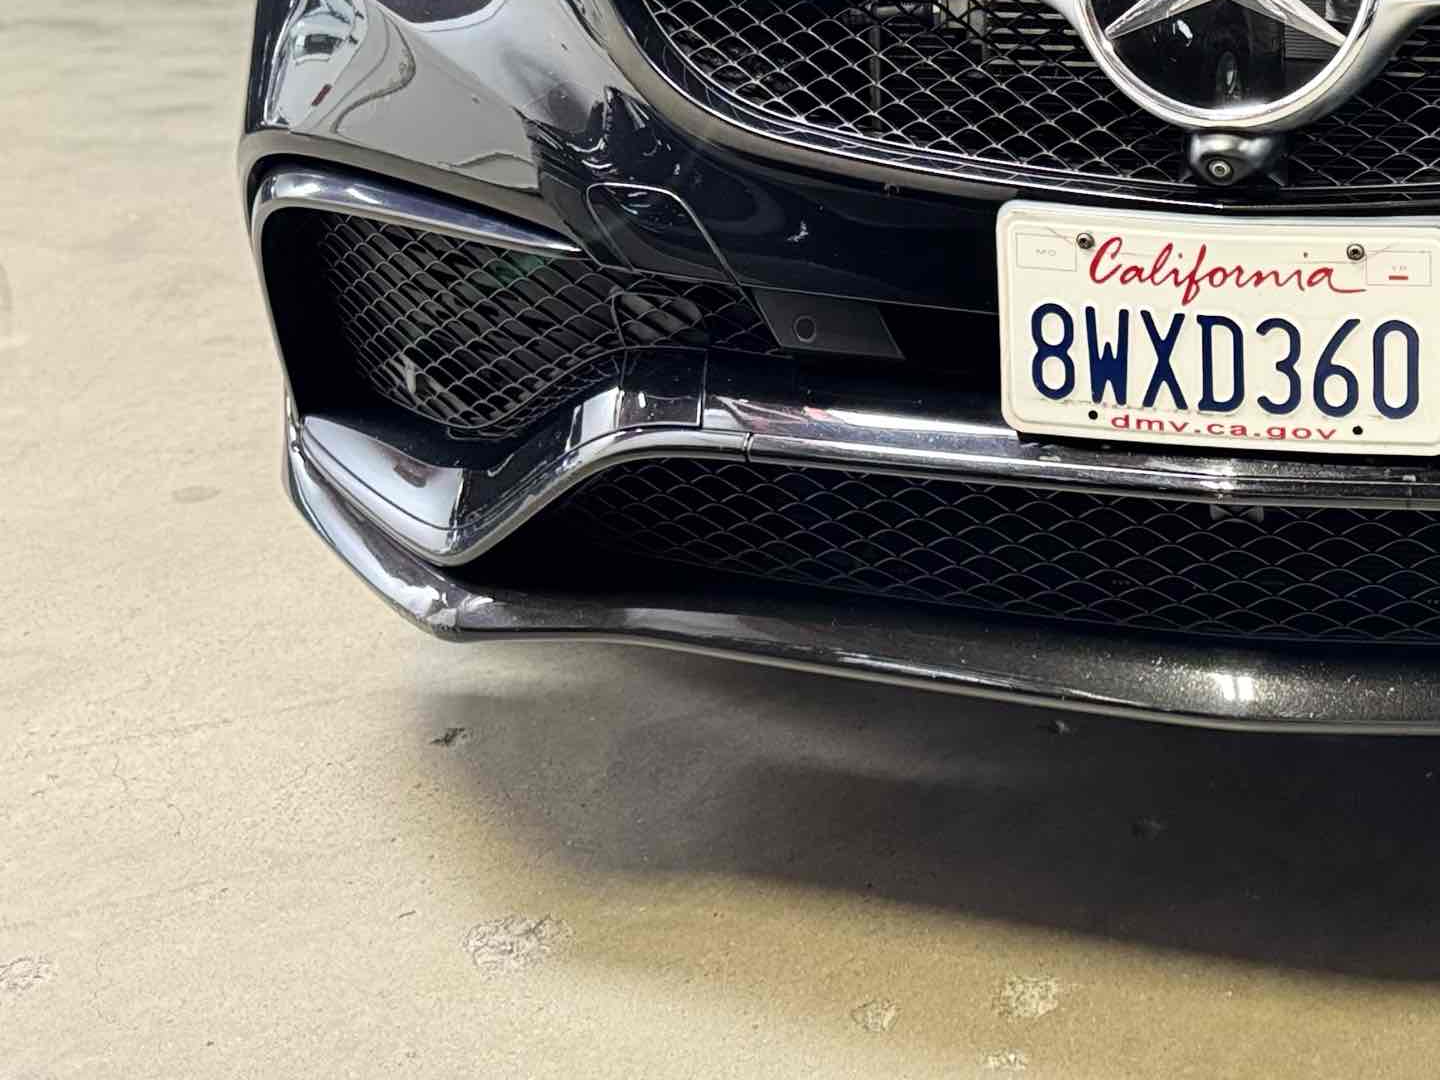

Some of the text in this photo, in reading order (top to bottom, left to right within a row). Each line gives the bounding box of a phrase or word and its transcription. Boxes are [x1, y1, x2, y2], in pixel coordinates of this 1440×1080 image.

[1088, 236, 1367, 306] California
[1030, 302, 1420, 420] 8WXD360
[1111, 414, 1336, 440] dmv.ca.gov
